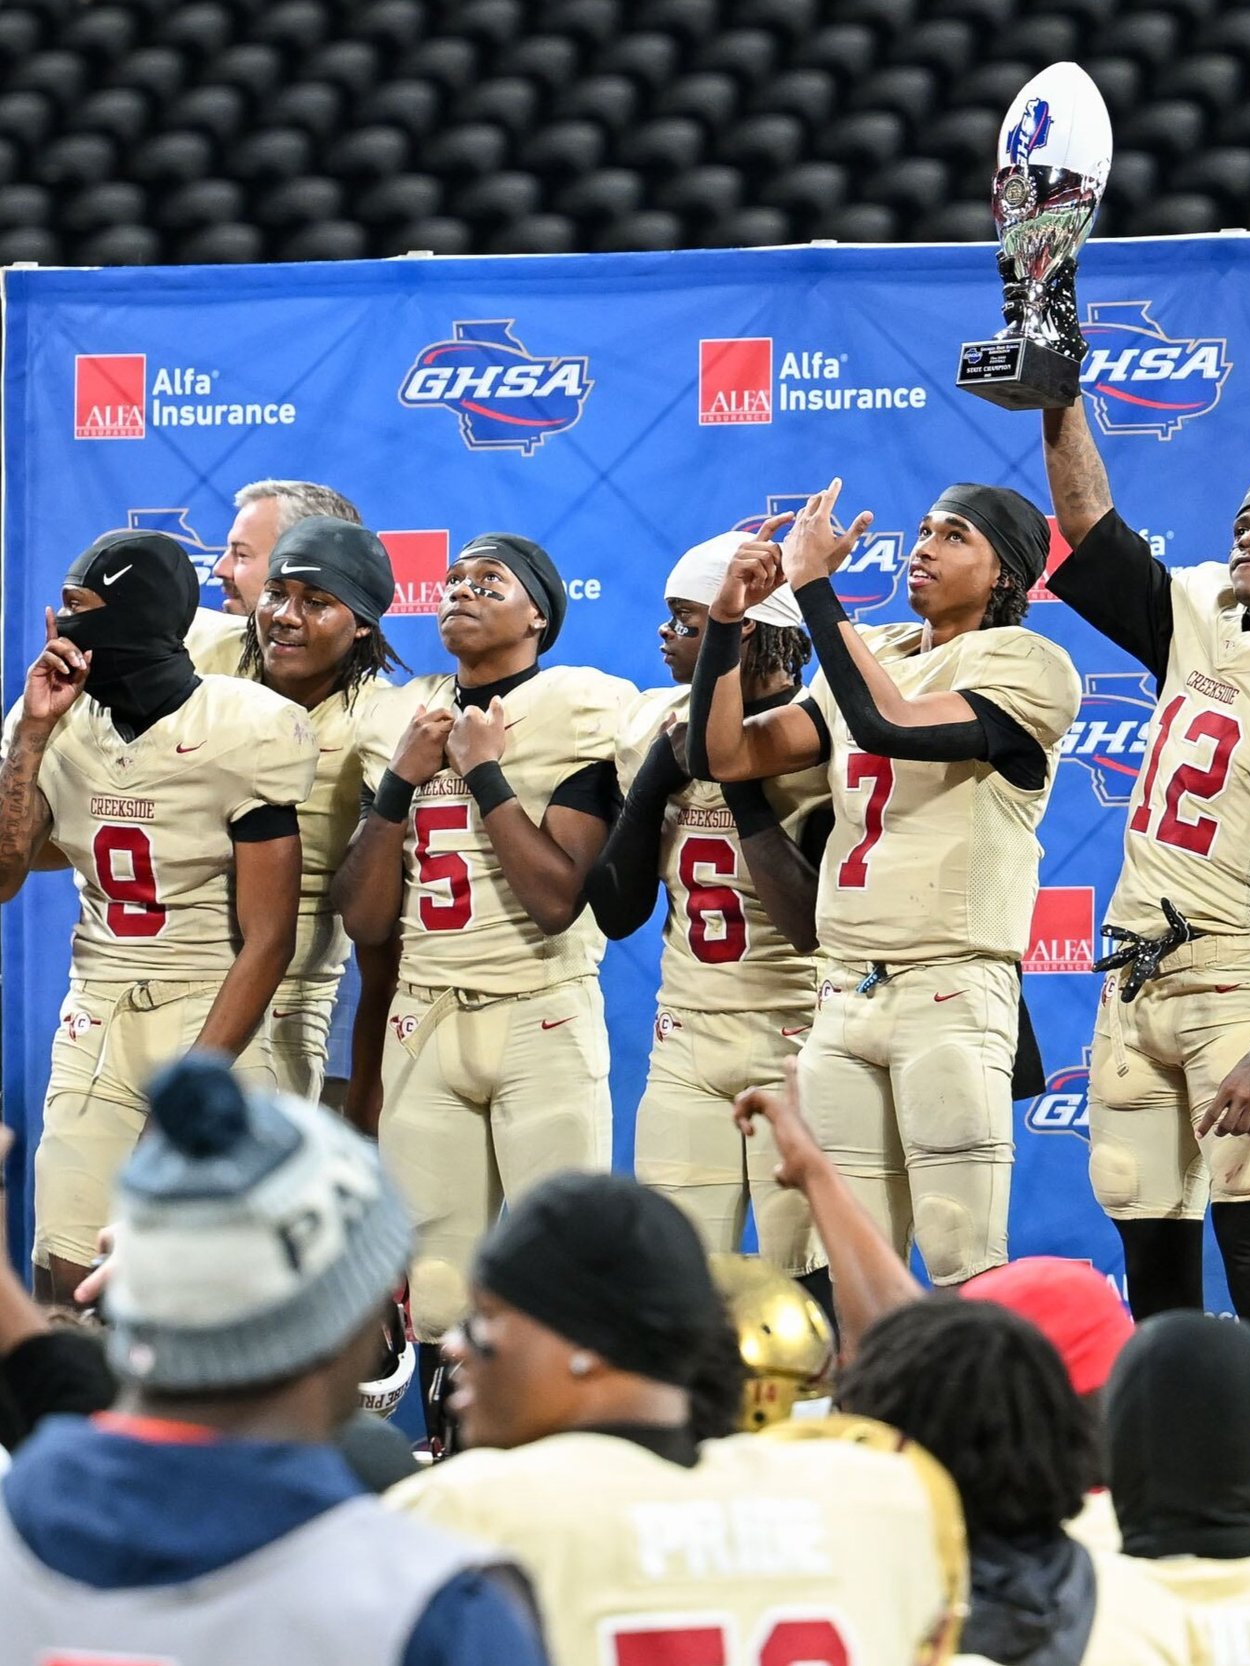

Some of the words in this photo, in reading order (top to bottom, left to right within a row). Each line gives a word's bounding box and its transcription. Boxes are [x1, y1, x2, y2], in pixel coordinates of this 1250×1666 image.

[779, 351, 840, 380] Alfa
[1079, 346, 1221, 383] HSA
[152, 367, 212, 396] Alfa
[404, 364, 583, 400] GHSA
[779, 383, 927, 411] Insurance
[85, 405, 144, 427] ALFA
[152, 398, 296, 427] Insurance
[710, 389, 771, 413] ALFA
[1186, 670, 1240, 705] CREEKSIDE
[1128, 693, 1242, 859] 12
[90, 797, 155, 819] CREEKSIDE
[836, 752, 895, 889] 7
[92, 823, 167, 938] 9
[414, 803, 474, 931] 5
[679, 835, 748, 964] 6
[1030, 939, 1093, 961] ALFA
